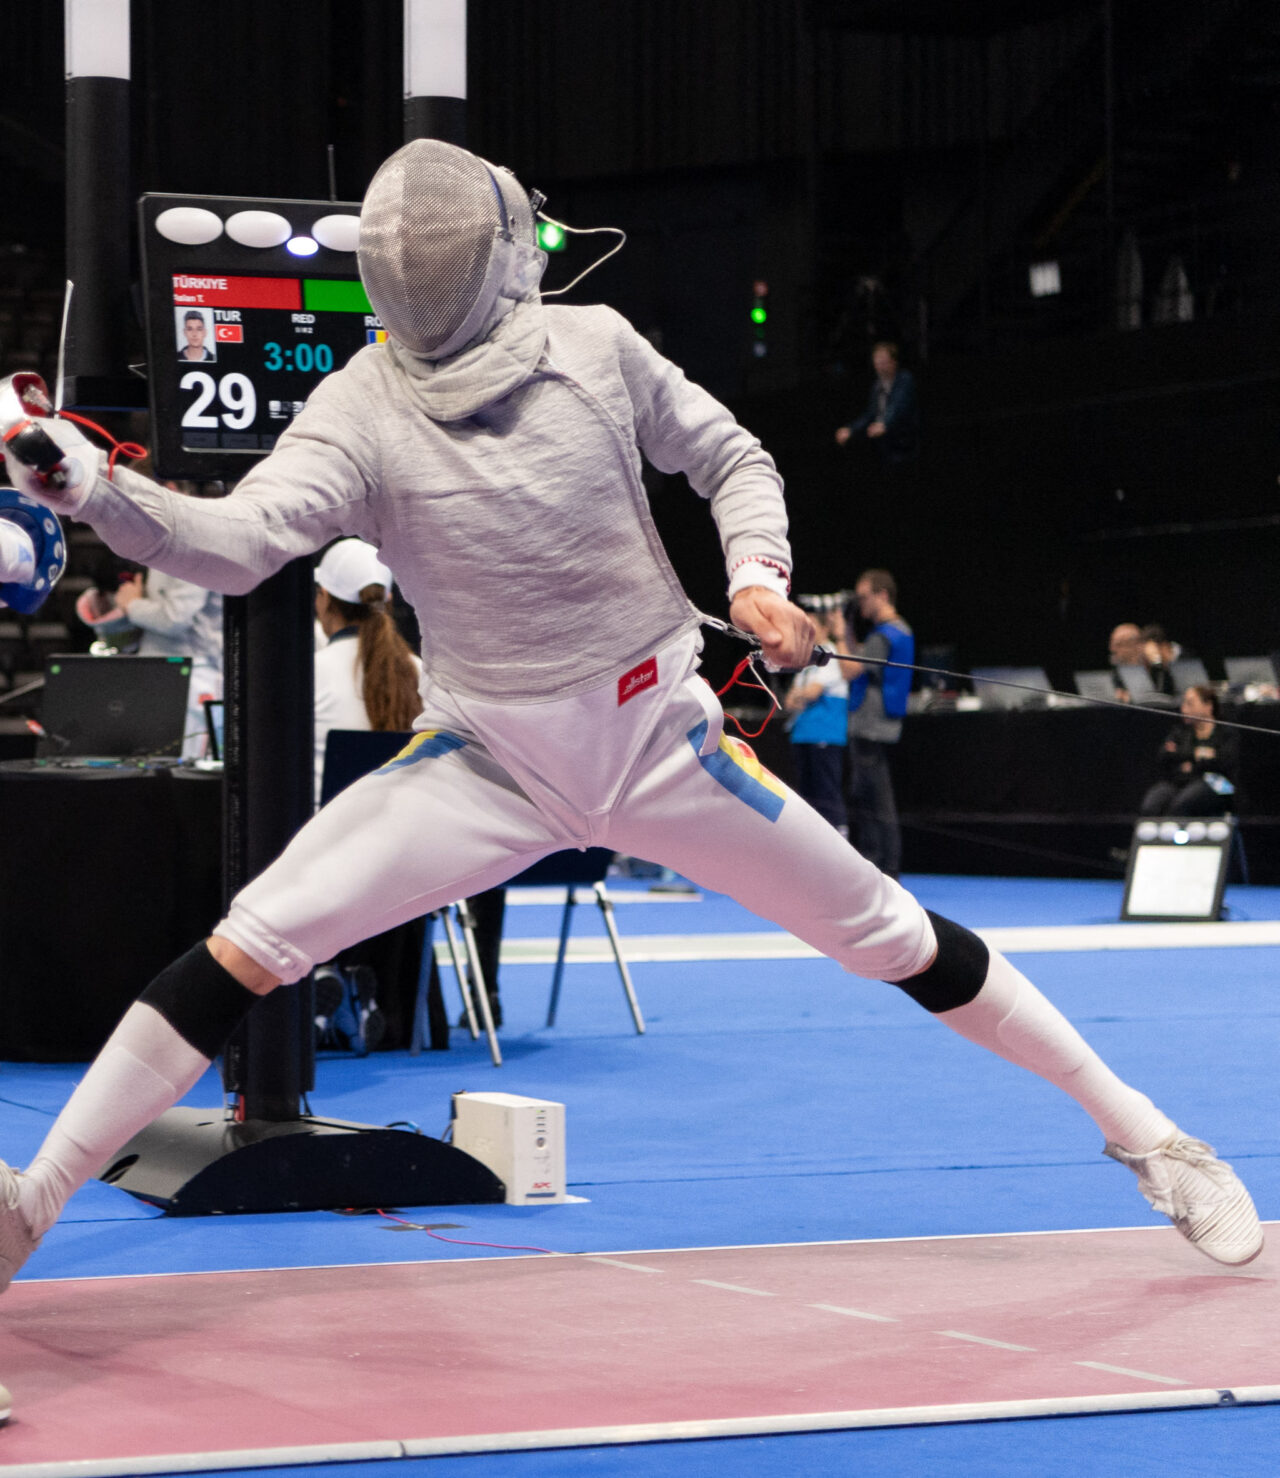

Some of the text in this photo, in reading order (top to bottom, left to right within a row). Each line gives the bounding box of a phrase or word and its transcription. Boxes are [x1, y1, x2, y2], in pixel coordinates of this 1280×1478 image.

[214, 310, 242, 322] TUR
[291, 313, 316, 324] RED
[364, 315, 384, 327] RO
[263, 342, 334, 373] 3:00
[179, 370, 257, 430] 29
